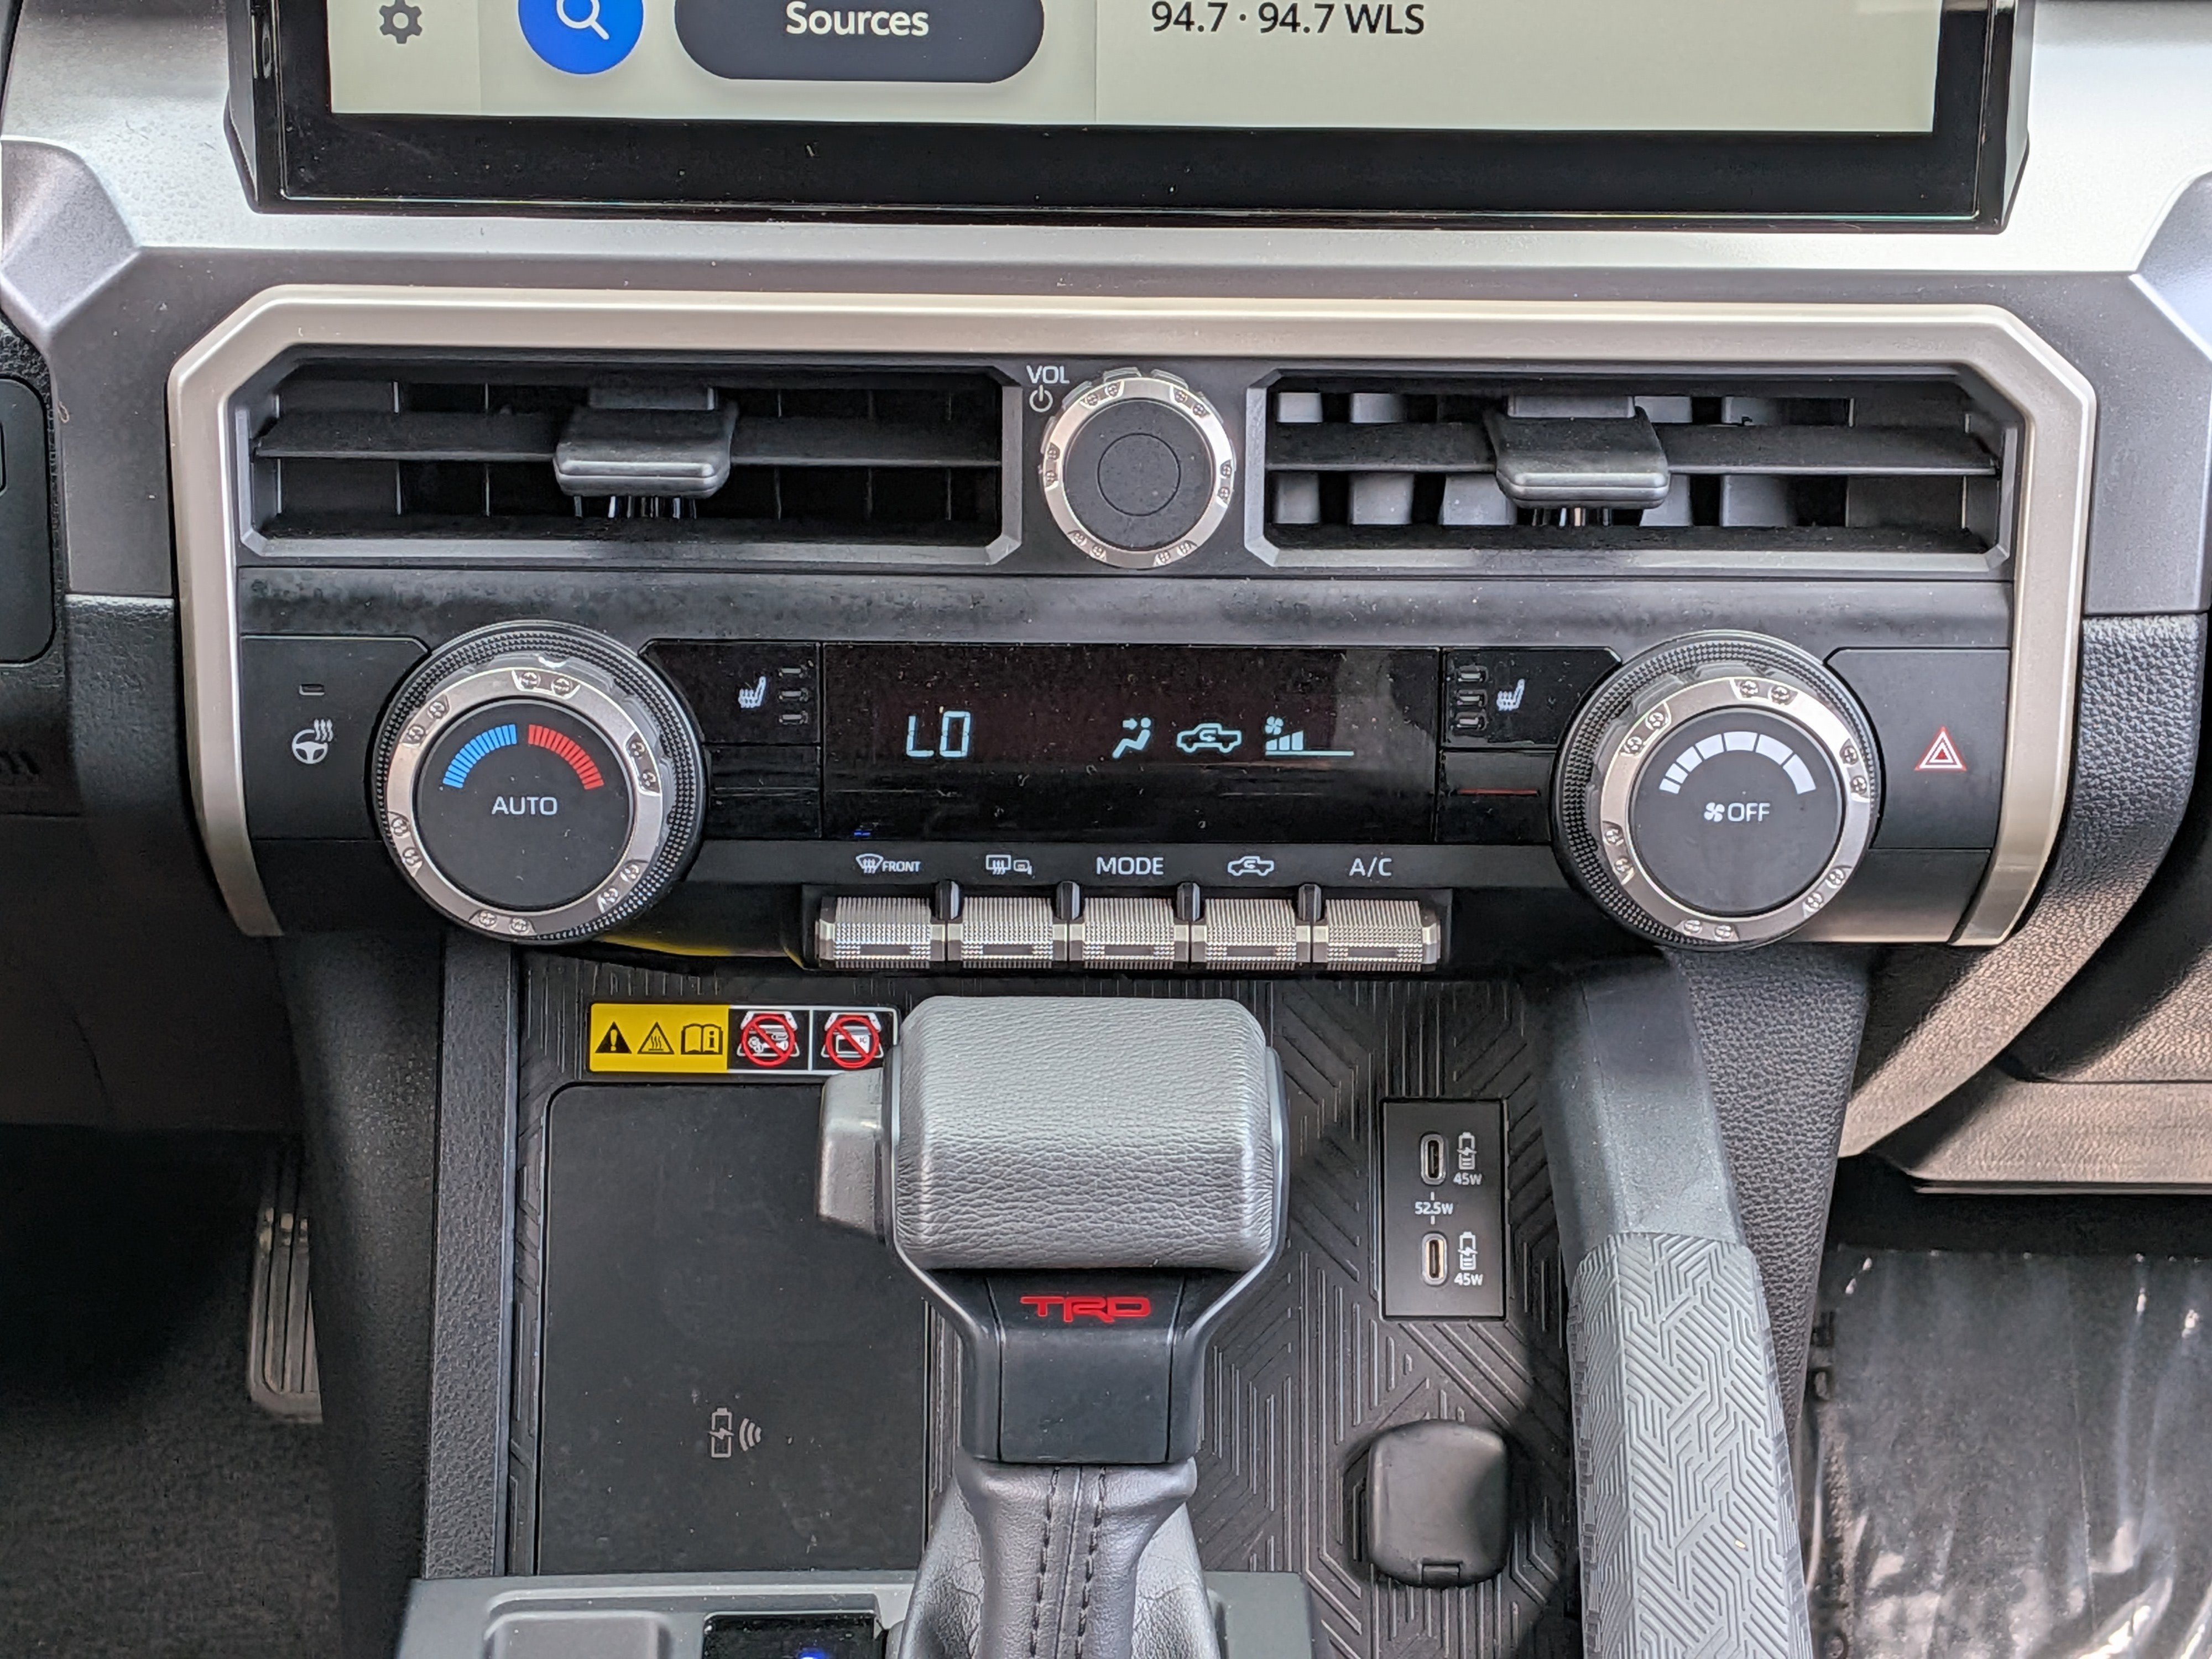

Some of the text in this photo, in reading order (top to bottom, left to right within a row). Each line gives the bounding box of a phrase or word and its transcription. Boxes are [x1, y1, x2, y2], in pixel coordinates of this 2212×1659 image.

[785, 1, 930, 37] Sources
[1152, 2, 1228, 33] 94.7
[1258, 3, 1334, 34] 94.7
[1344, 4, 1425, 34] WLS
[1026, 366, 1070, 384] VOL
[906, 711, 971, 758] LO
[492, 796, 558, 816] AUTO
[1728, 802, 1771, 822] OFF
[882, 860, 921, 873] FRONT
[1096, 857, 1165, 875] MODE
[1349, 858, 1393, 877] A/C
[1453, 1172, 1483, 1186] 45W
[1415, 1202, 1454, 1215] 52.5W
[1454, 1273, 1483, 1286] 45W
[1020, 1296, 1151, 1323] TRD
